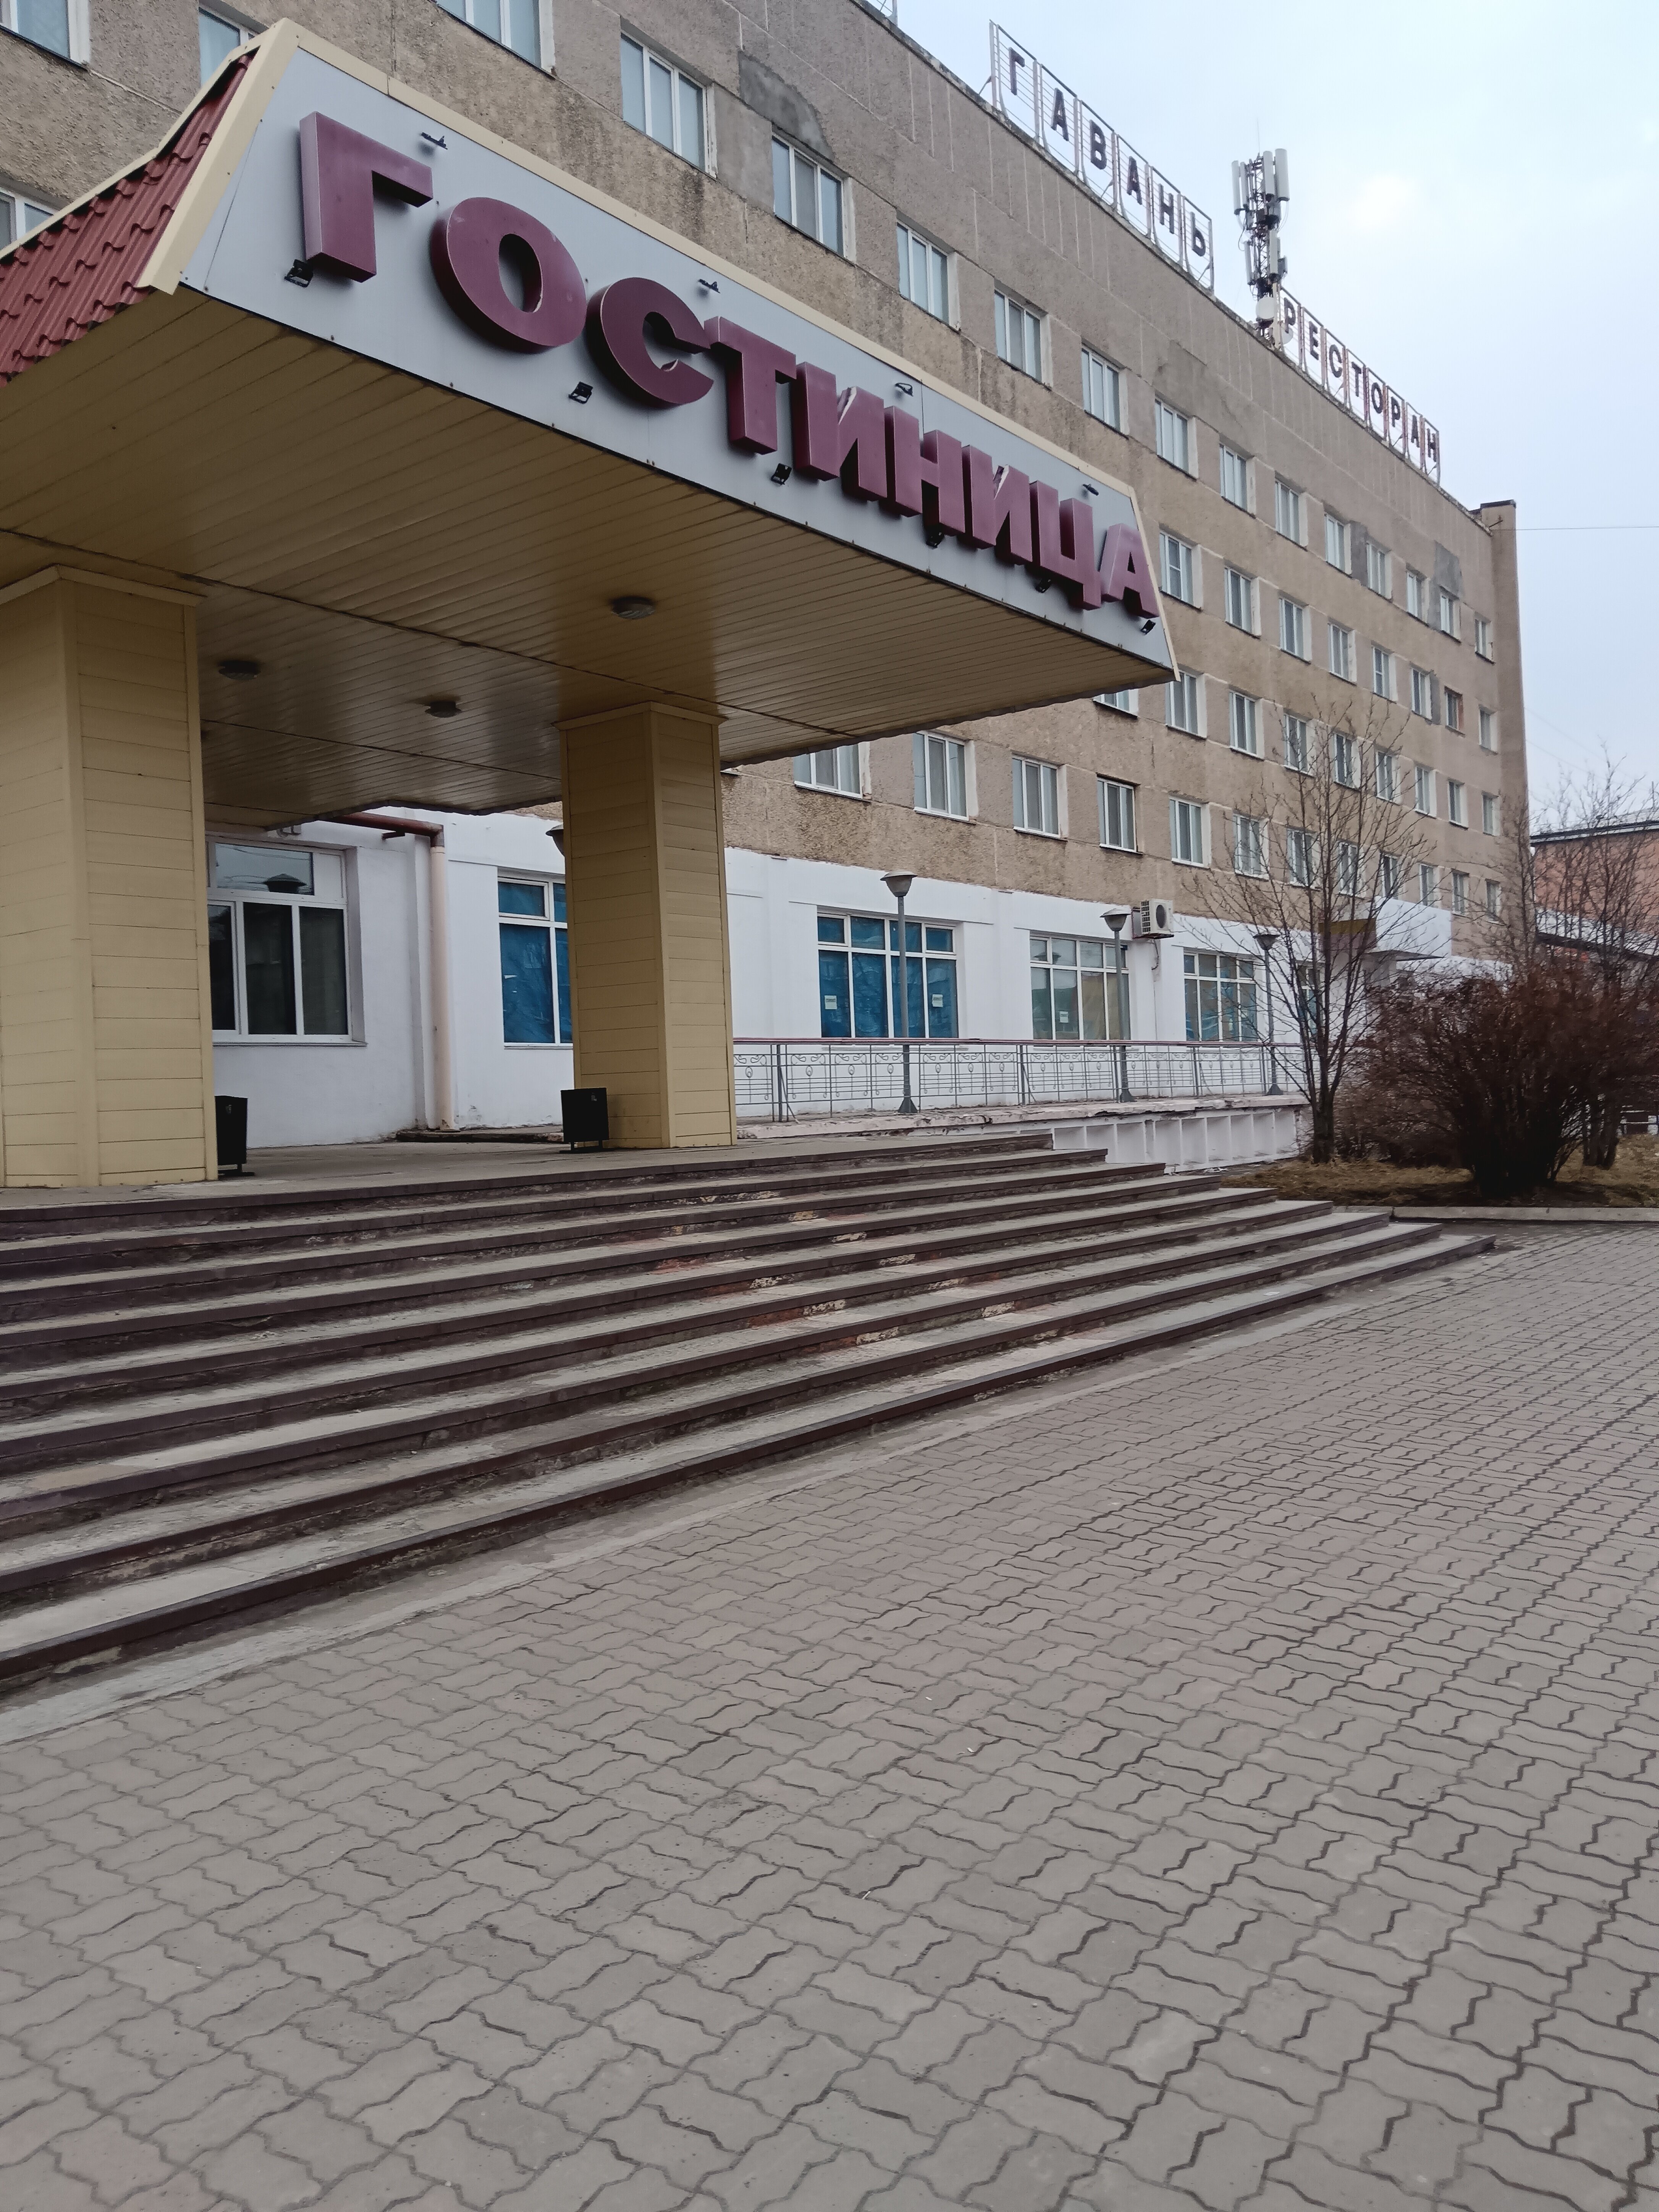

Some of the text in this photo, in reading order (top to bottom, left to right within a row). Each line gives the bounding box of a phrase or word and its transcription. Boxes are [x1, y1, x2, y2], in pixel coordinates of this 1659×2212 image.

[1009, 47, 1206, 257] ГАВАНЬ
[300, 111, 1159, 619] ГОСТИНИЦА
[1284, 297, 1437, 462] РЕСТОРАН
